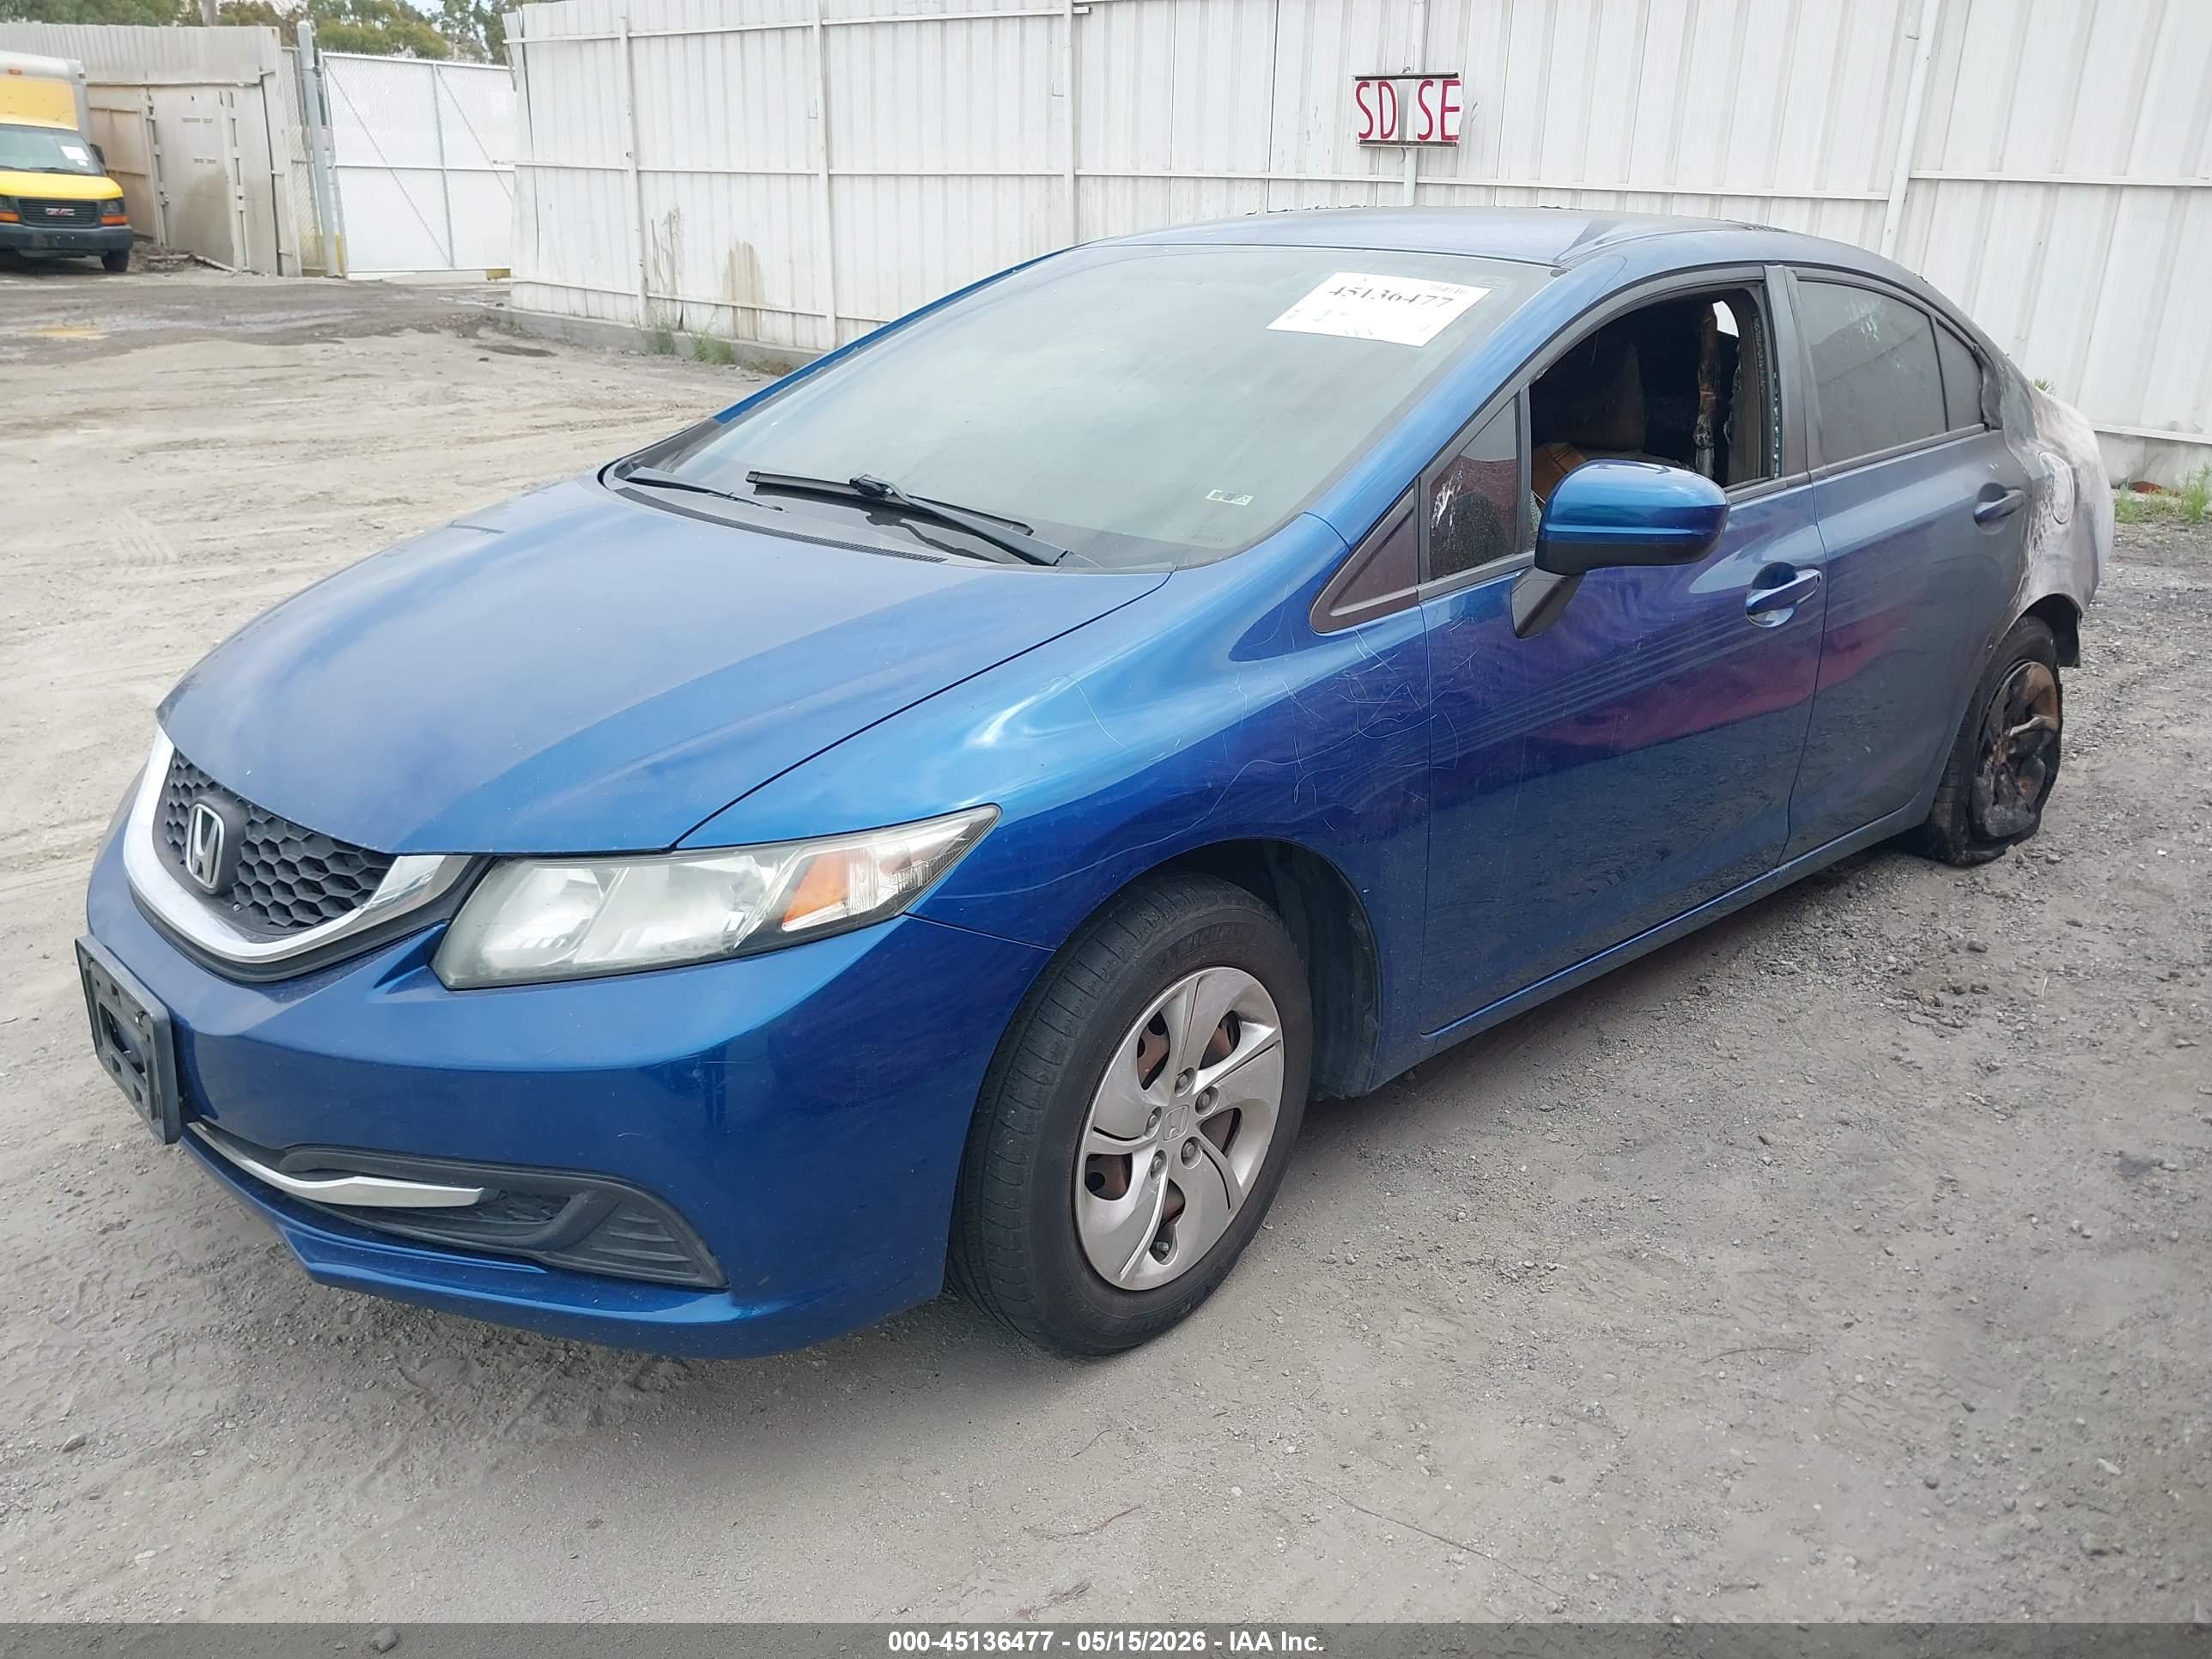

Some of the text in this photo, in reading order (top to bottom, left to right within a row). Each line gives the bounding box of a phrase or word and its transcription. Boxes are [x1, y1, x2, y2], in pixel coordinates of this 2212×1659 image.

[1355, 80, 1462, 141] SD SE
[1328, 285, 1455, 307] 45136477
